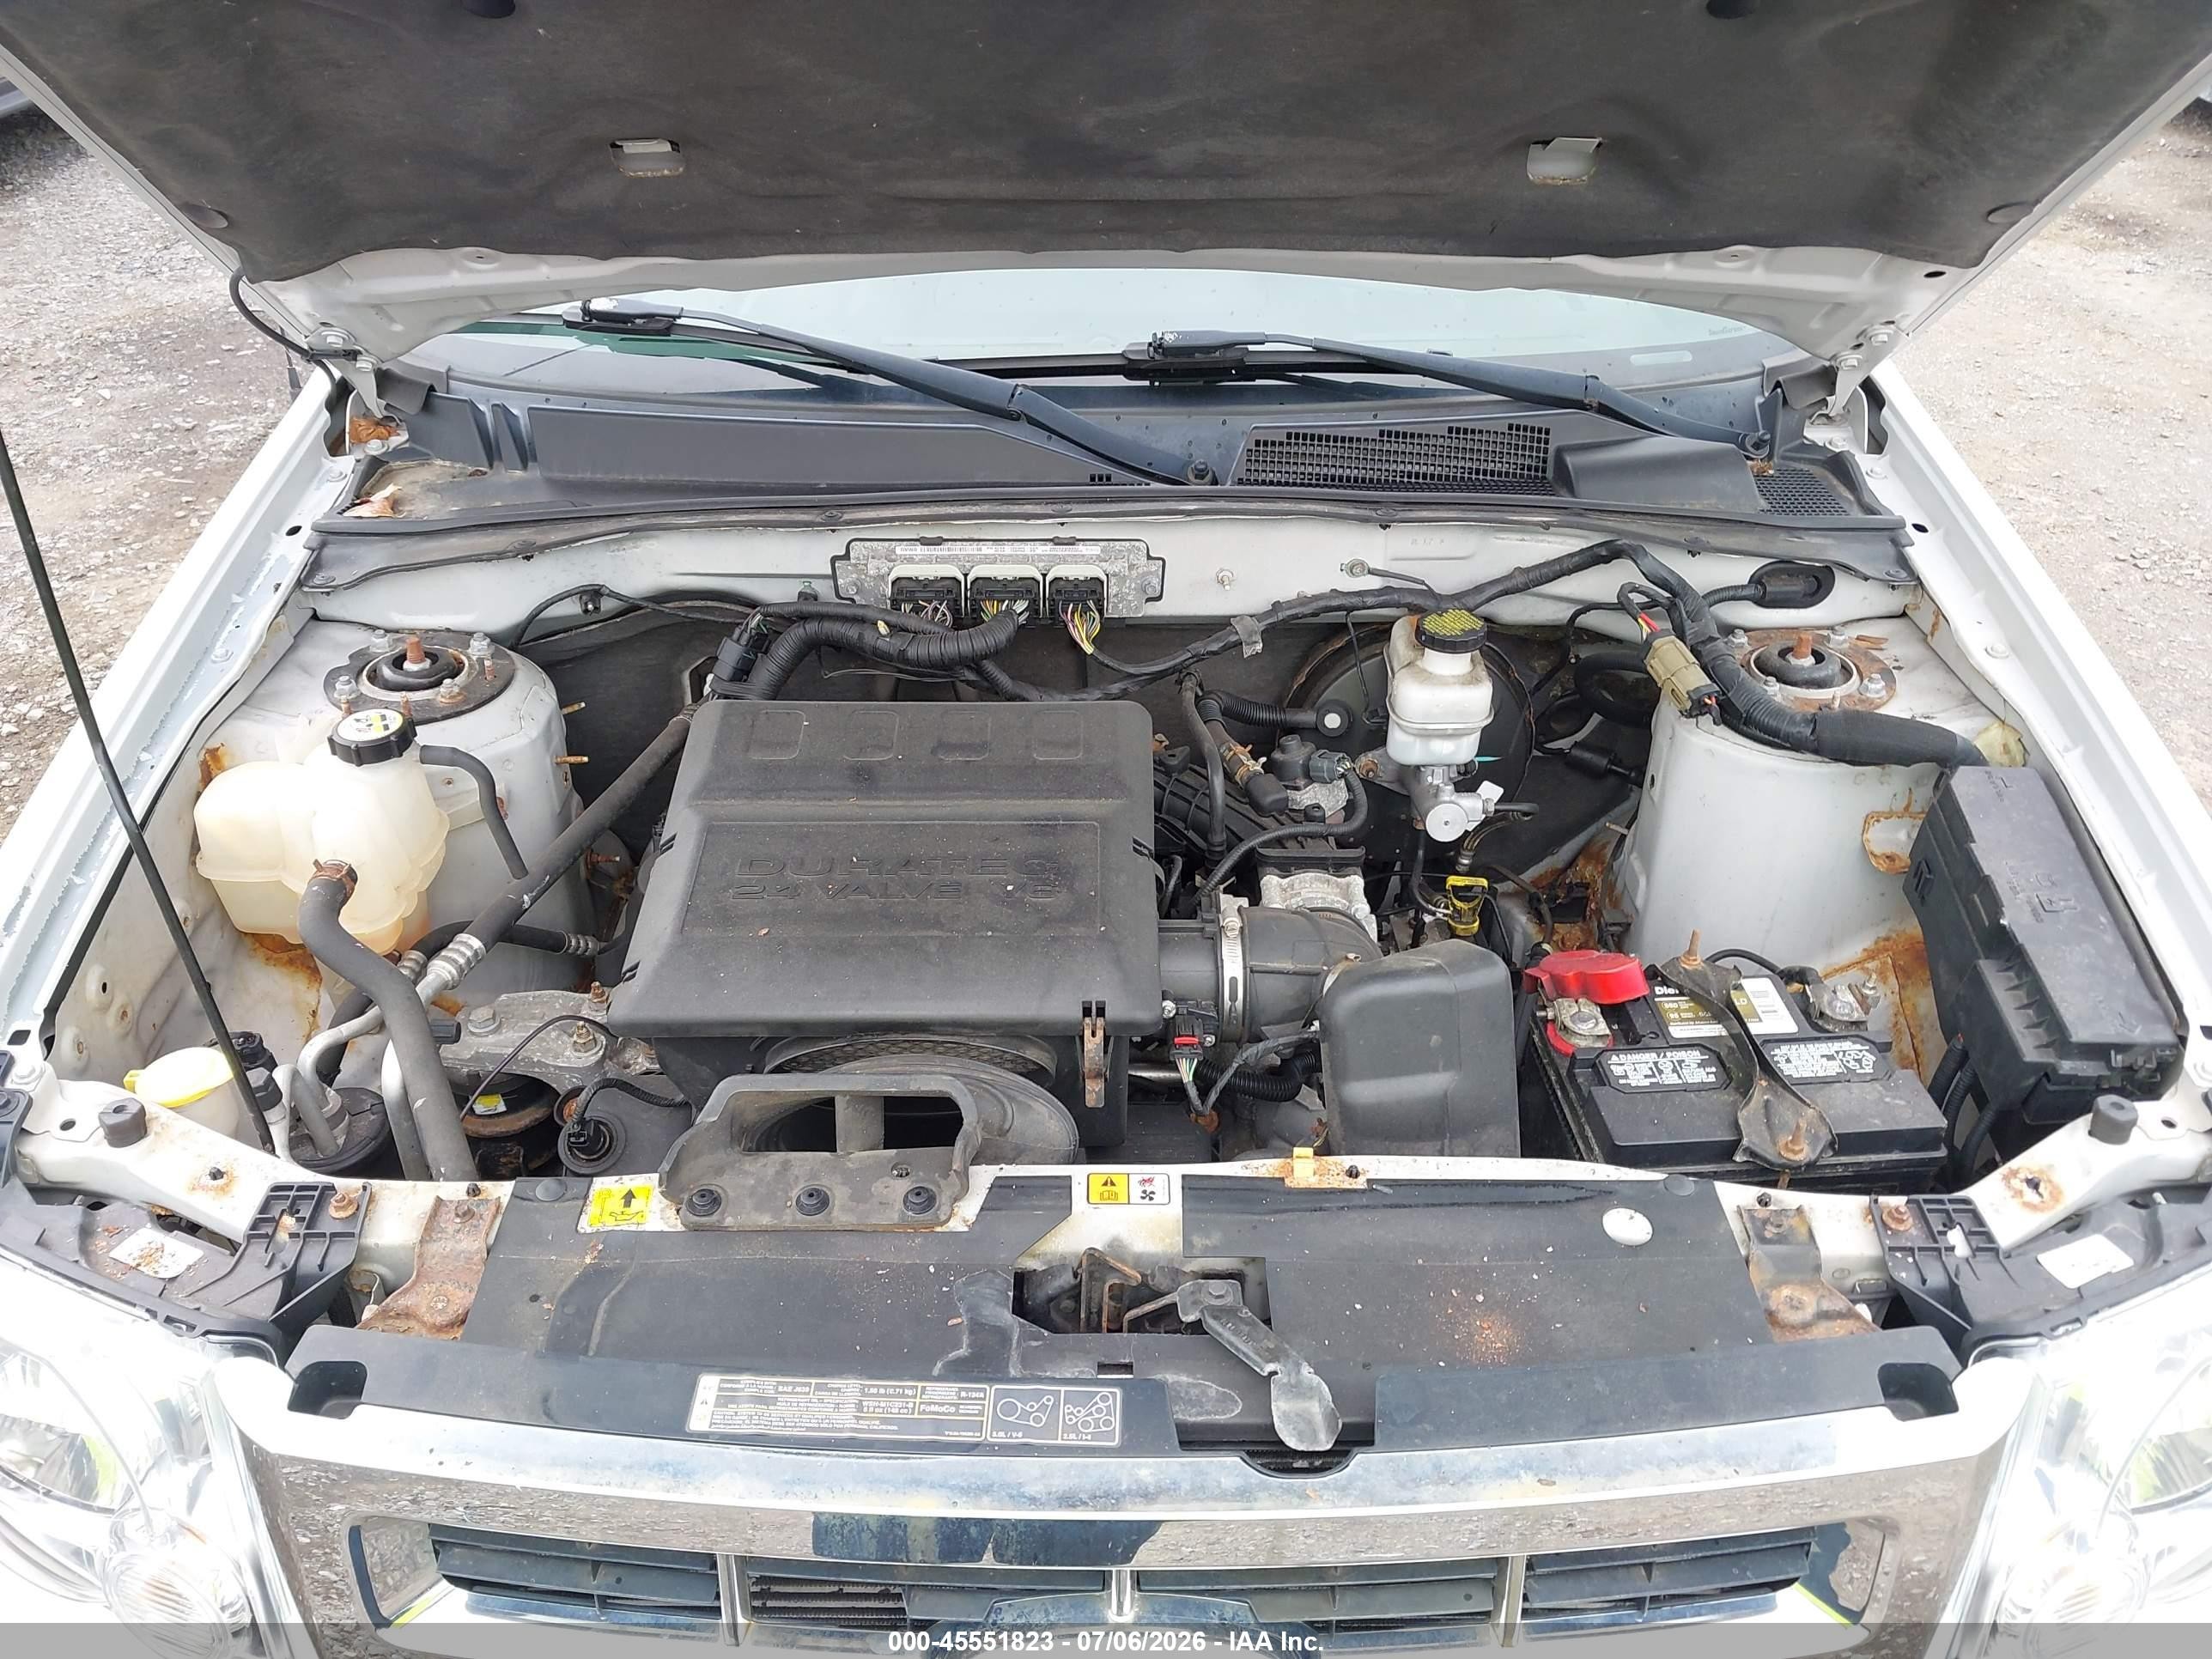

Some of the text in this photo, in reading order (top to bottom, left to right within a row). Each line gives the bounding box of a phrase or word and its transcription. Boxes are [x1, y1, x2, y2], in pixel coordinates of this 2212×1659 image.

[736, 858, 1059, 877] DURATEC
[731, 883, 804, 900] 24
[818, 882, 963, 900] VALVE
[1619, 1052, 1658, 1061] DANGER
[1666, 1050, 1702, 1059] POISON
[920, 1404, 955, 1413] FoMoCo
